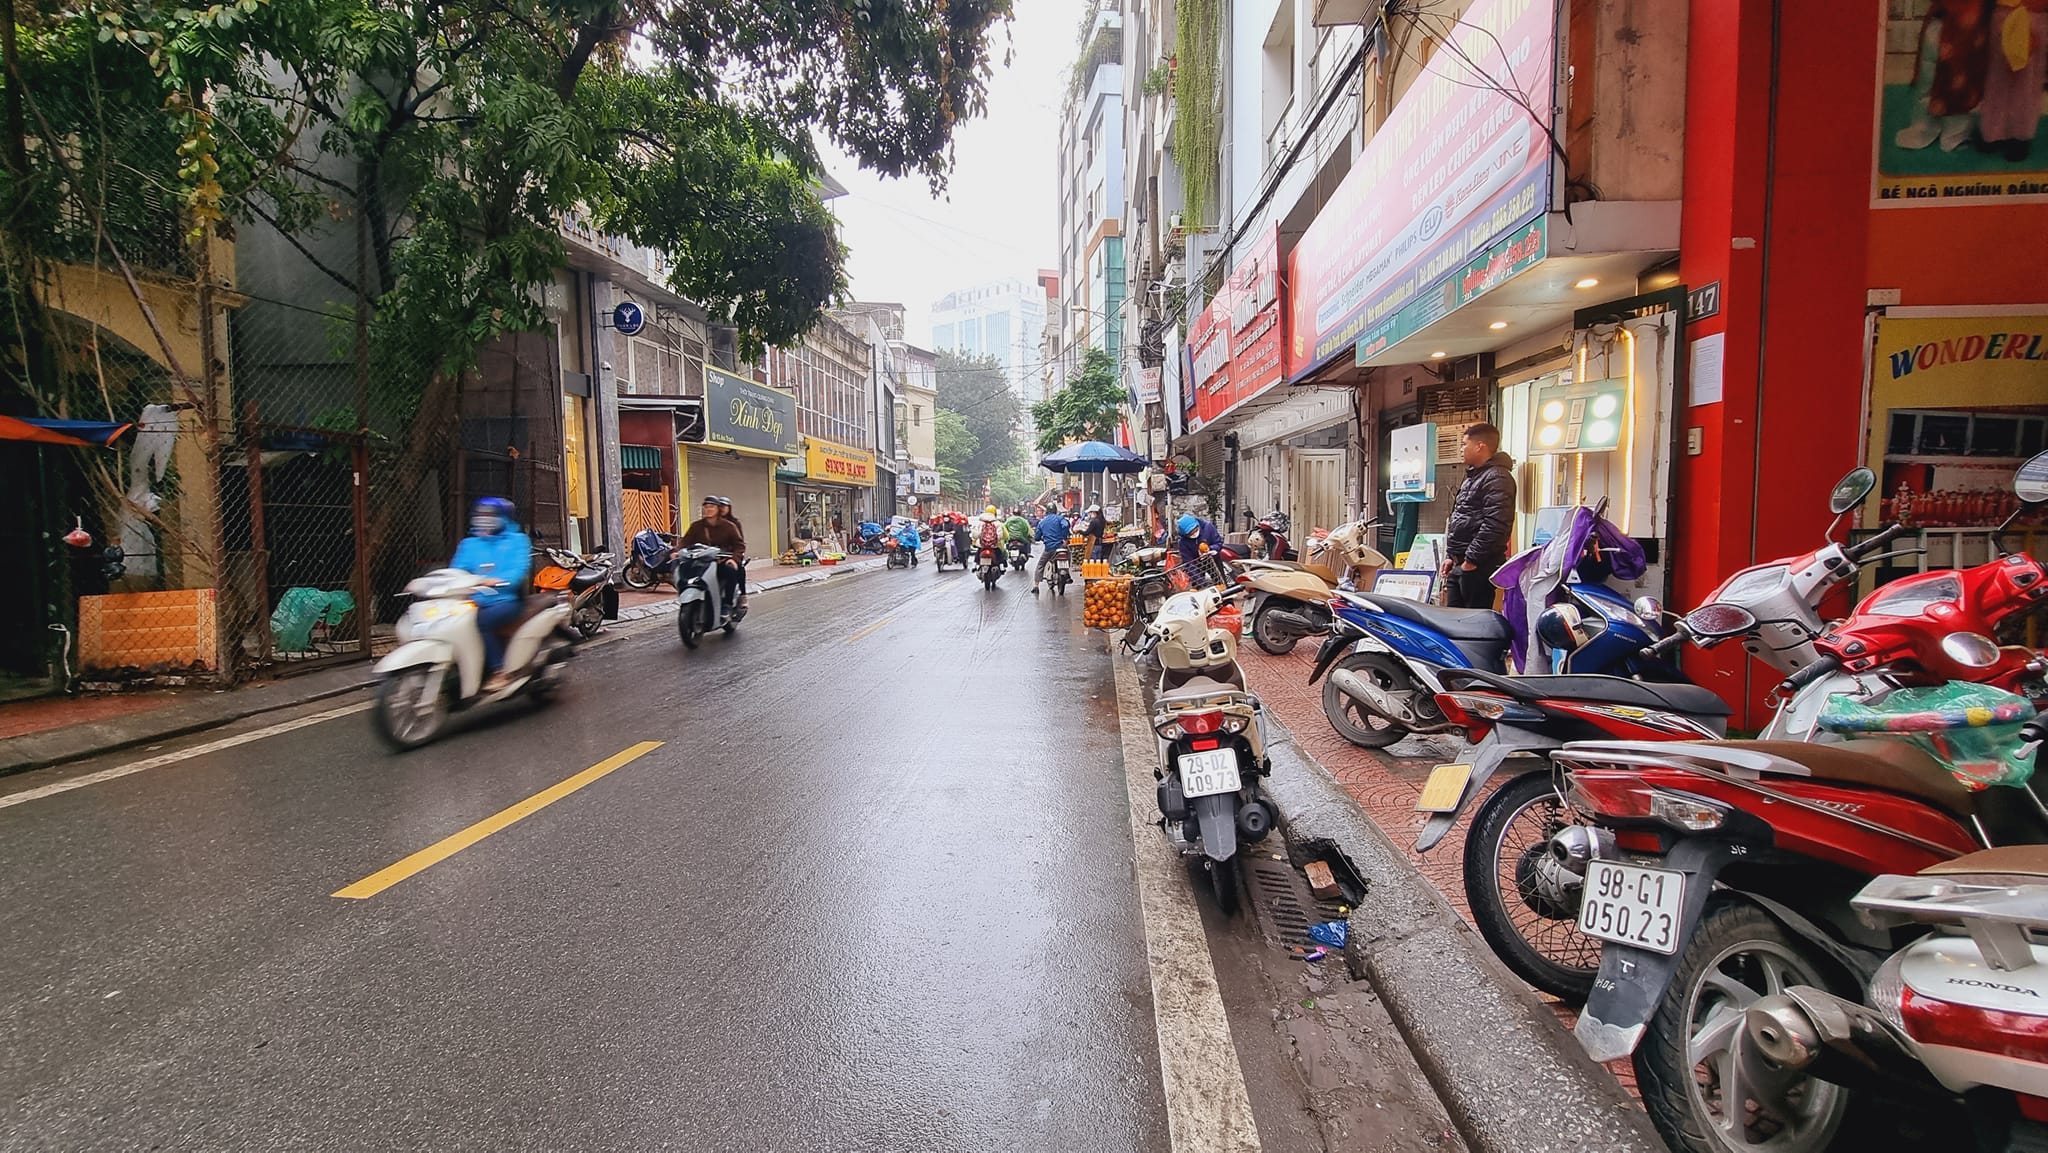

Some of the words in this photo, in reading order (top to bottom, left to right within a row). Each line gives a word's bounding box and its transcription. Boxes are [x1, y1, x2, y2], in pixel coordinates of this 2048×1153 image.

[1881, 185, 1901, 199] BÉ
[1424, 210, 1439, 234] ELV
[1687, 286, 1717, 319] 147
[1889, 333, 2048, 379] WONDERL
[708, 370, 725, 388] Shop
[730, 397, 760, 430] Xinh
[1187, 770, 1237, 793] 409.73
[1598, 867, 1665, 908] 98-G1
[1584, 899, 1672, 946] 050.23
[1945, 978, 2041, 998] HONDA
